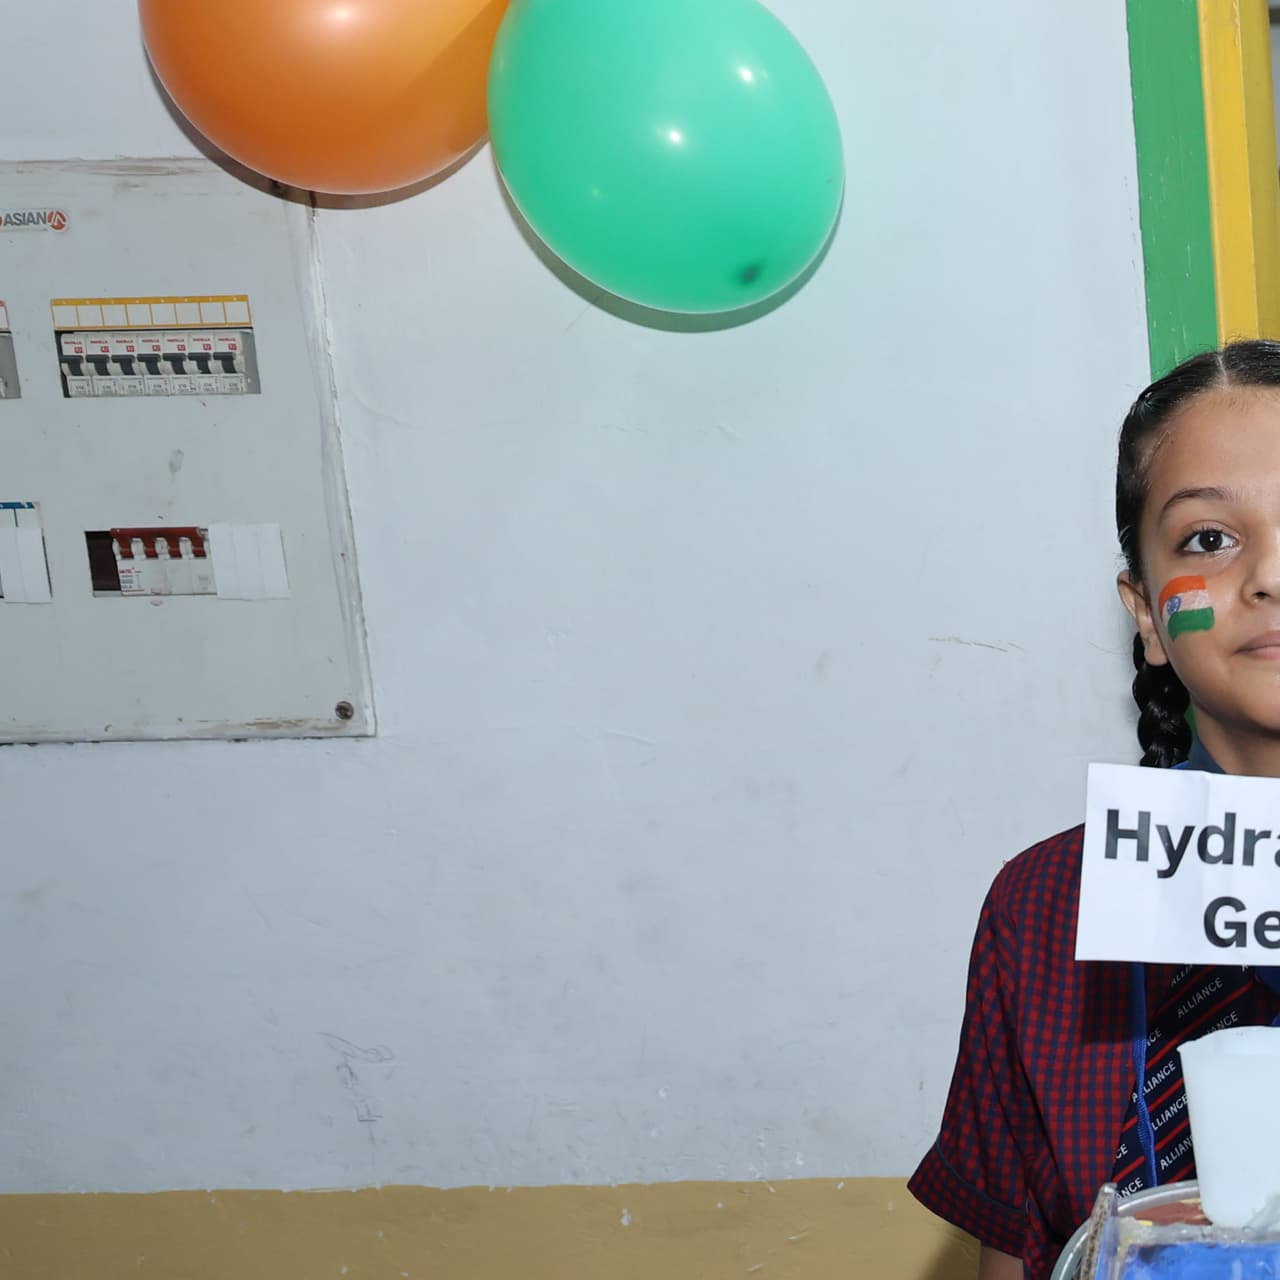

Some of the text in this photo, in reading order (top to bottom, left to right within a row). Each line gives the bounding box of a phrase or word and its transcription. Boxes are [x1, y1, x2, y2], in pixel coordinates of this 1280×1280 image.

[3, 211, 47, 227] ASIAN
[1177, 977, 1224, 1018] ALLIANCE
[1132, 1060, 1176, 1103] ALIANCE
[1152, 1094, 1188, 1131] LLIANCE
